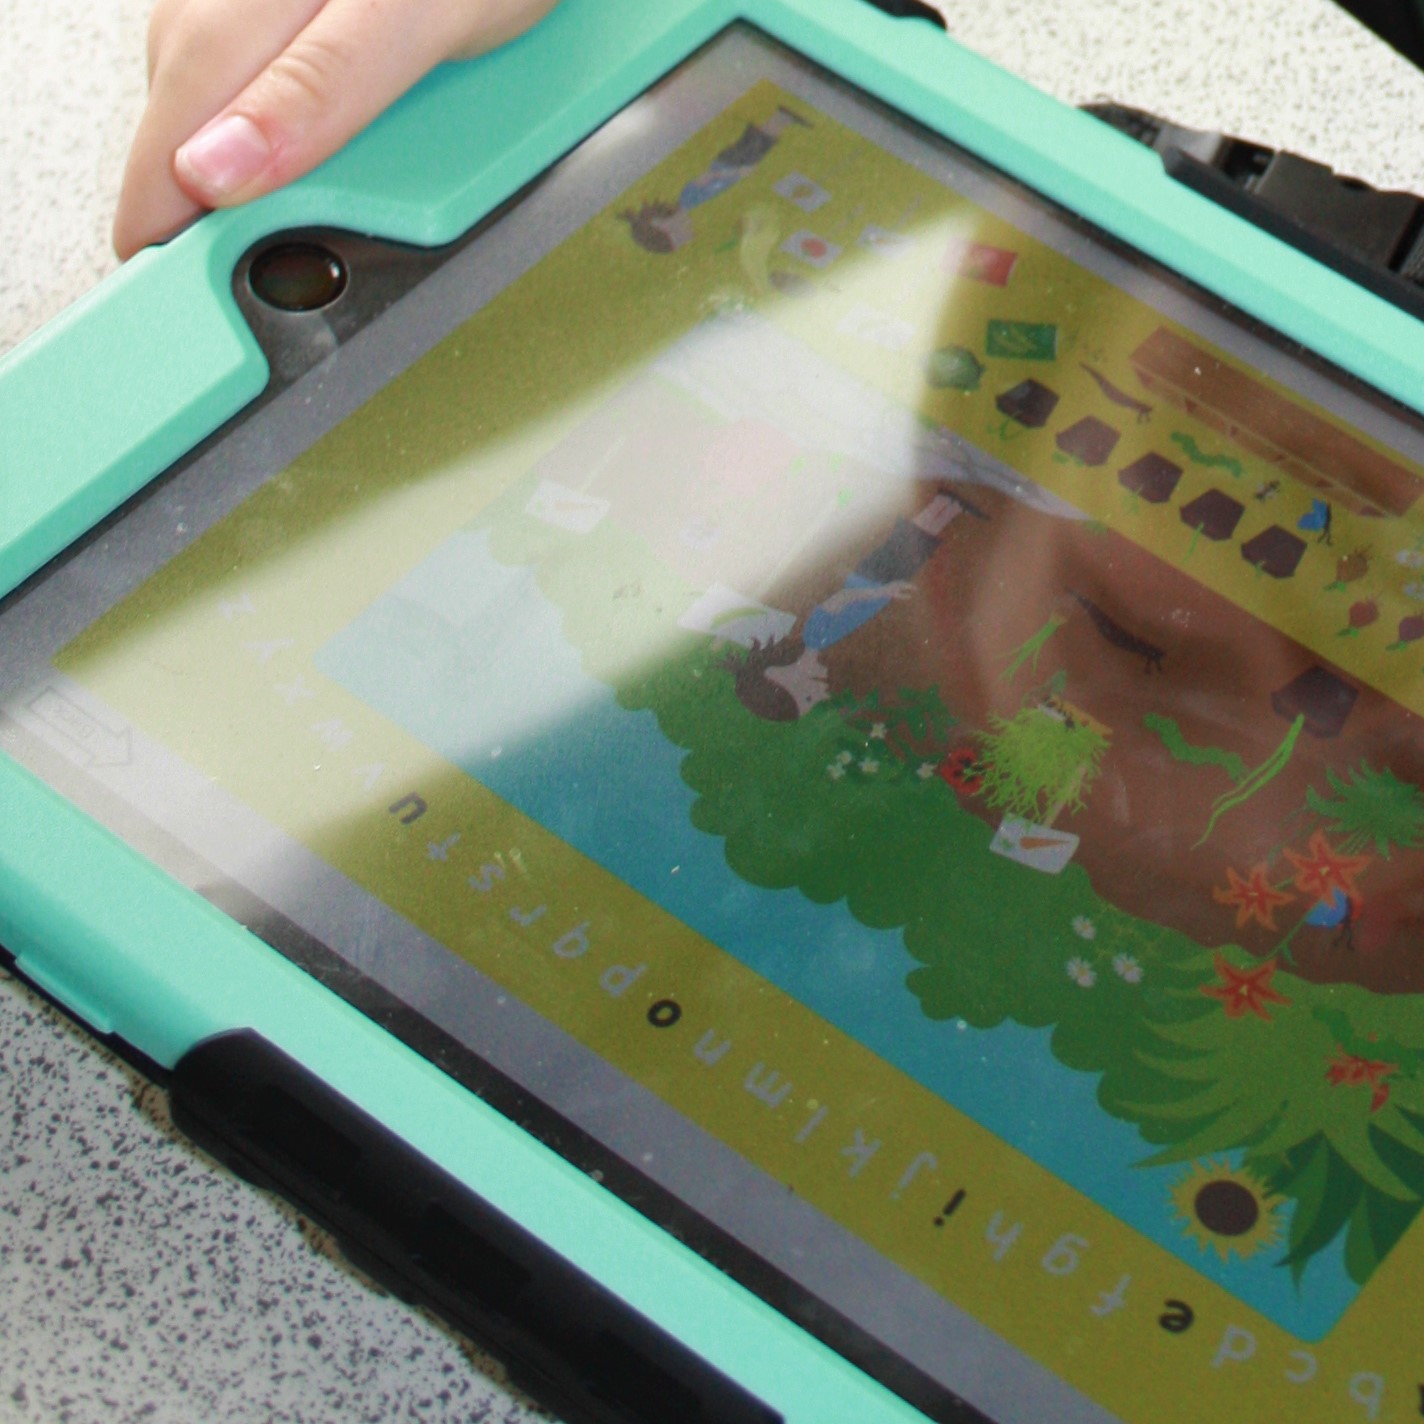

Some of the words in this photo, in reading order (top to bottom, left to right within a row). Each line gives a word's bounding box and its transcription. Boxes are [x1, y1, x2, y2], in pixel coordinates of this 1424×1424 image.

[389, 792, 428, 824] u
[425, 833, 461, 861] t
[468, 862, 506, 892] s
[509, 904, 548, 927] r
[553, 921, 591, 959] q
[600, 962, 649, 997] p
[647, 999, 682, 1028] o
[694, 1028, 731, 1067] n
[744, 1062, 792, 1108] m
[796, 1106, 828, 1144] l
[840, 1127, 882, 1178] k
[891, 1152, 938, 1200] j
[933, 1189, 967, 1227] i
[985, 1209, 1022, 1261] h
[1041, 1232, 1089, 1275] g
[1090, 1273, 1133, 1317] f
[1158, 1299, 1194, 1333] e
[1211, 1325, 1256, 1369] d
[1284, 1349, 1318, 1384] c
[1348, 1371, 1385, 1419] b
